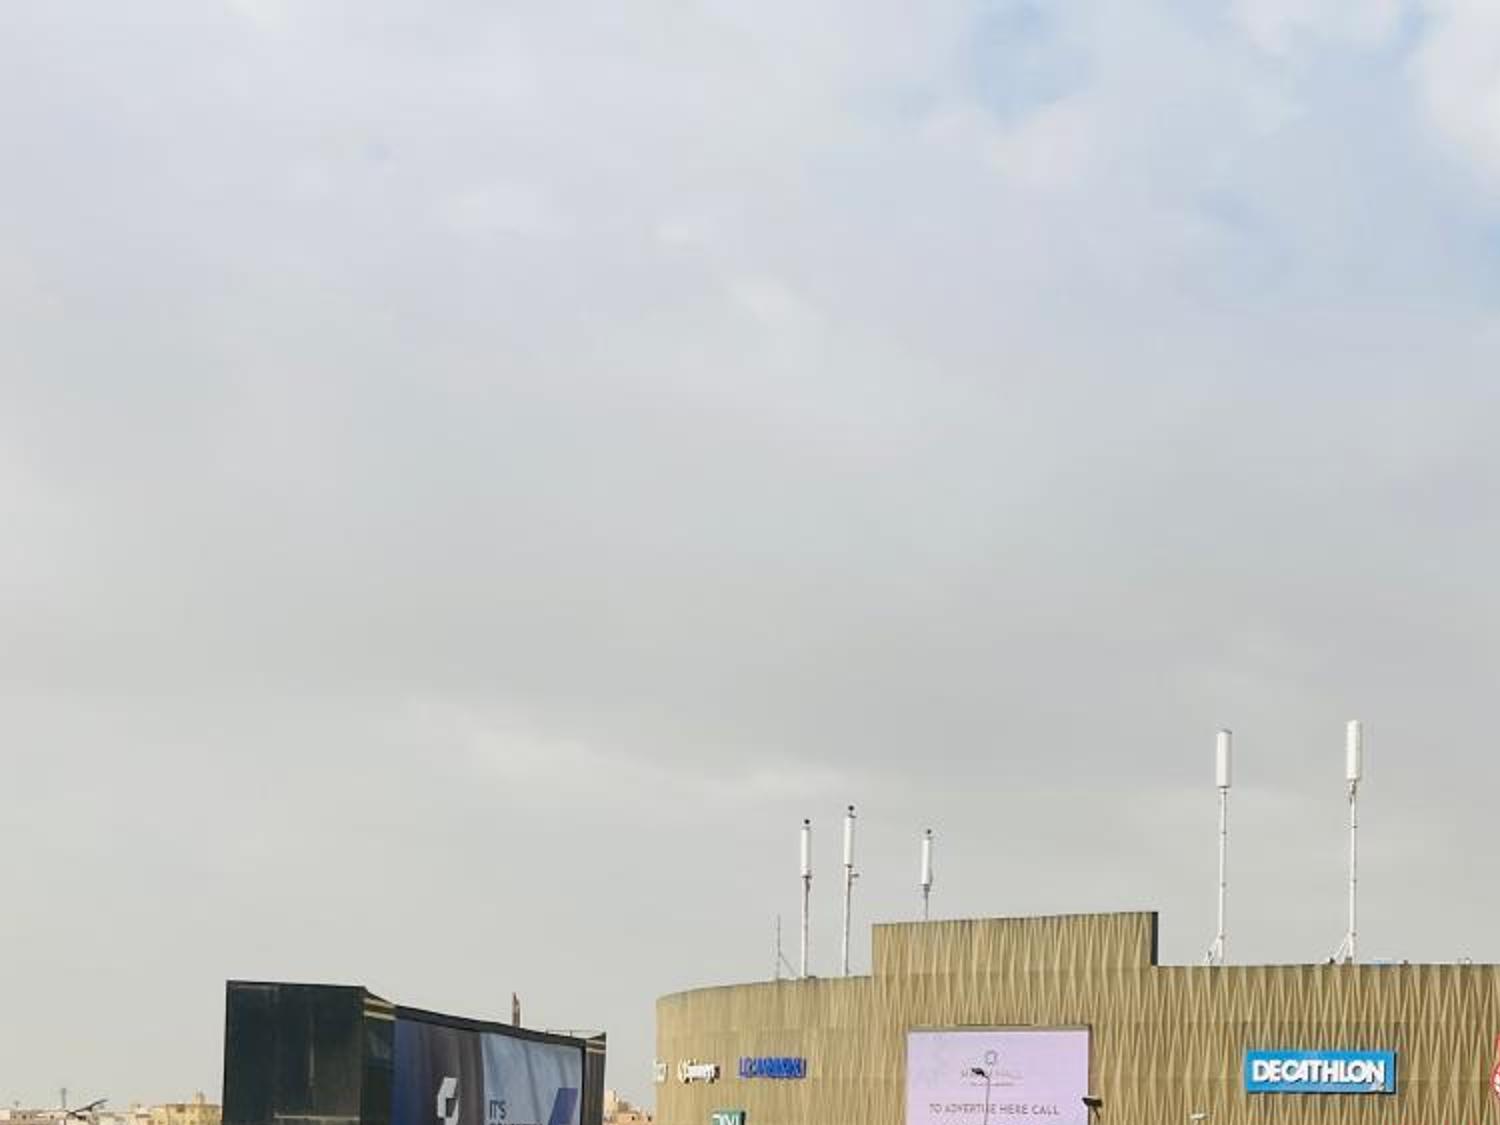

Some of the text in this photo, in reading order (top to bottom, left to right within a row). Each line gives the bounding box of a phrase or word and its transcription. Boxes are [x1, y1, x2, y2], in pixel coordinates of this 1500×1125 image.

[1252, 1059, 1386, 1083] DECATHLON
[489, 1100, 507, 1119] IT'S
[929, 1103, 943, 1113] TO
[999, 1104, 1028, 1115] HERE
[1031, 1105, 1060, 1115] CALL
